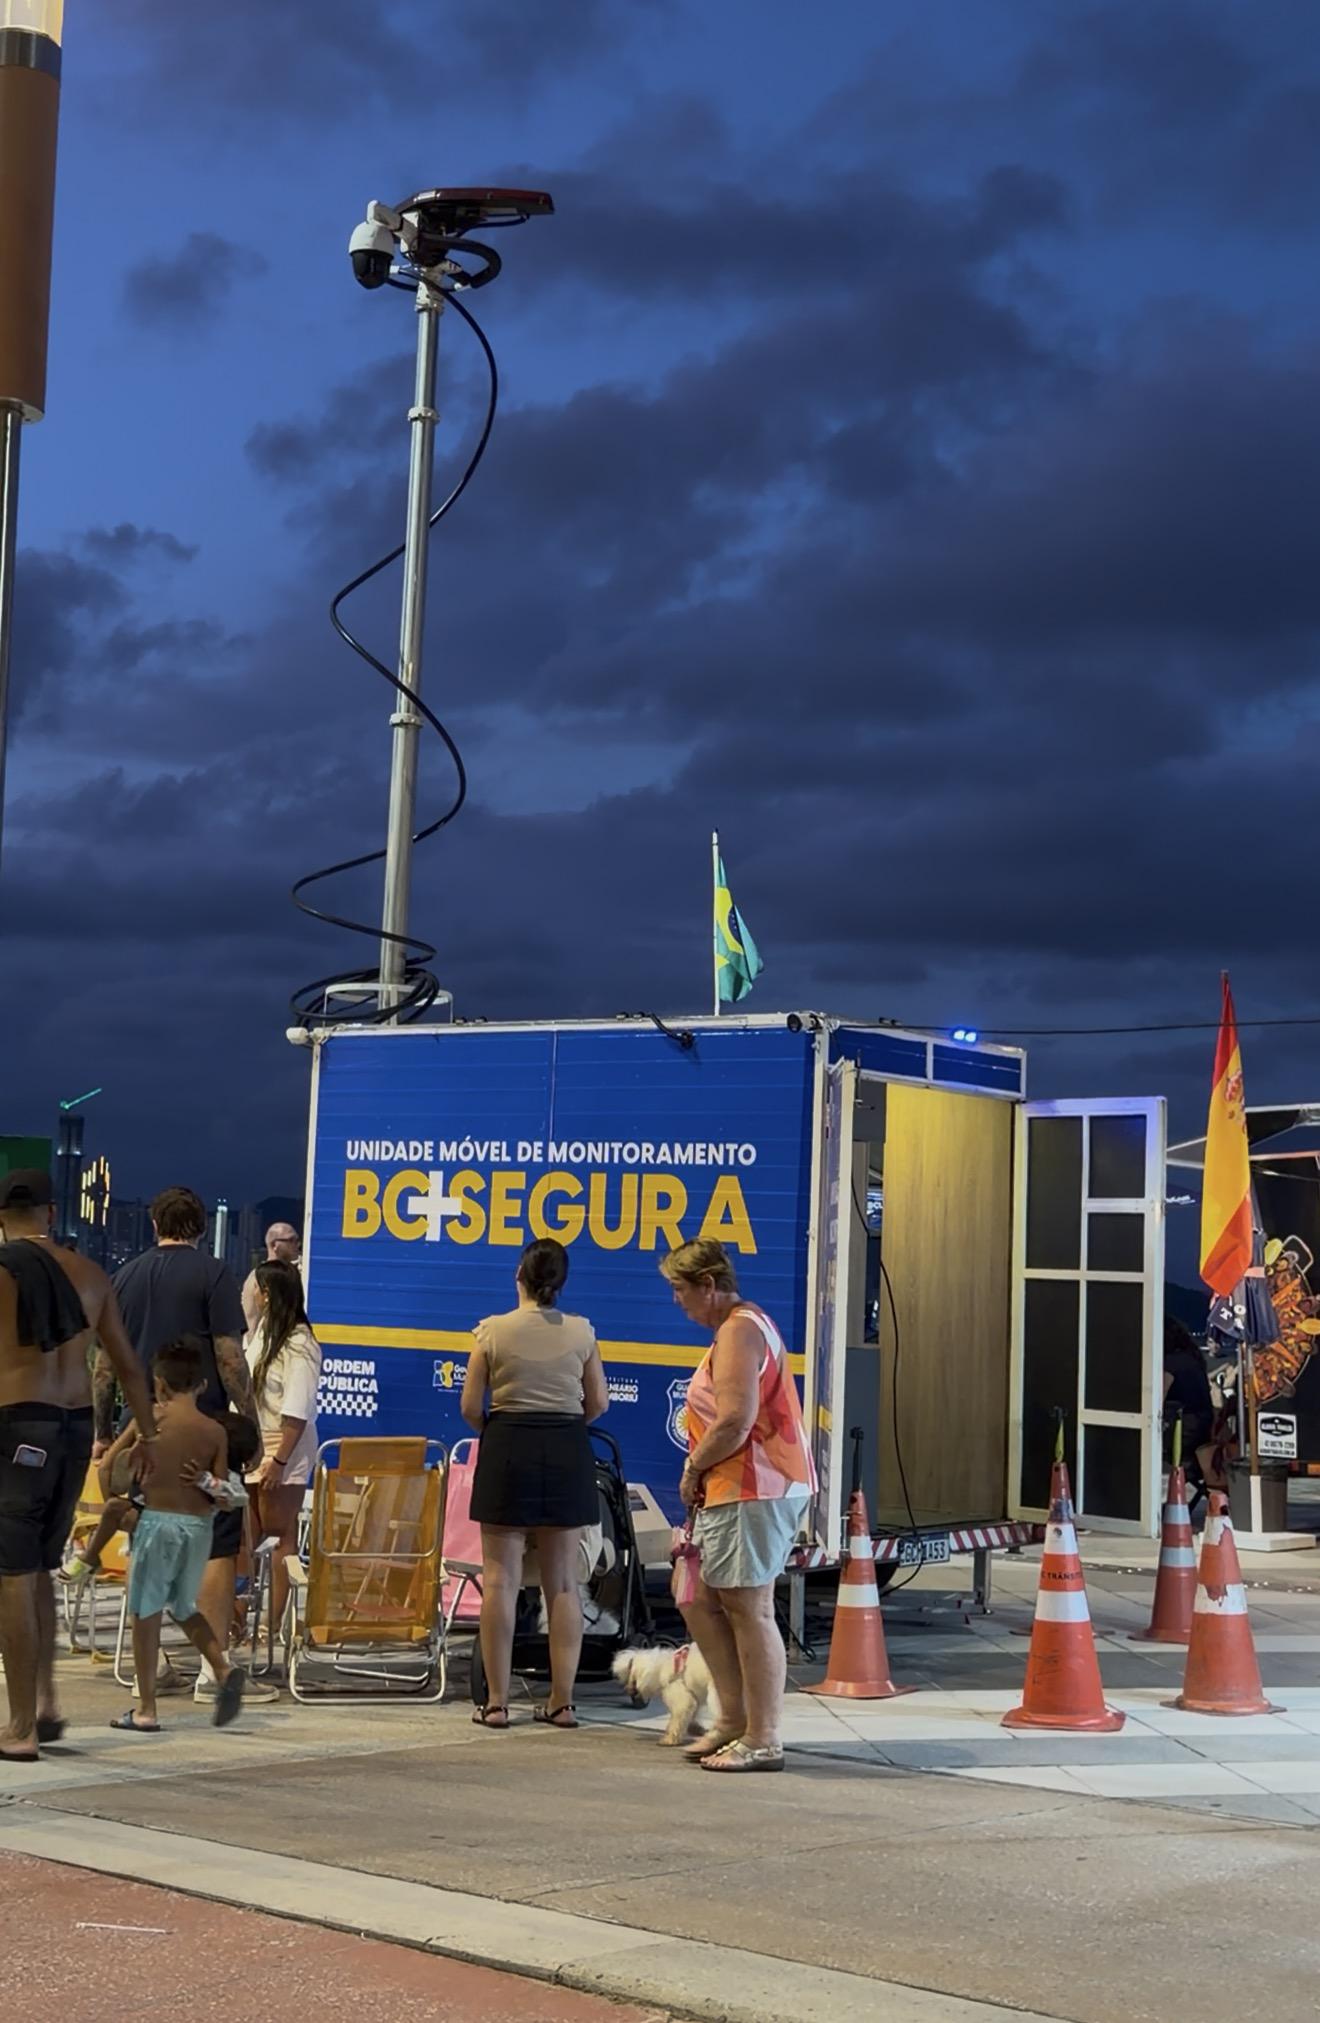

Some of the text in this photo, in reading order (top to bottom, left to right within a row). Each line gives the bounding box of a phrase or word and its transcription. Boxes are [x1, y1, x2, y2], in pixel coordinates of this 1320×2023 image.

[346, 1135, 757, 1166] UNIDADE MÓVEL DE MONITORAMENTO
[323, 1359, 375, 1375] ORDEM
[318, 1373, 378, 1393] PÚBLICA
